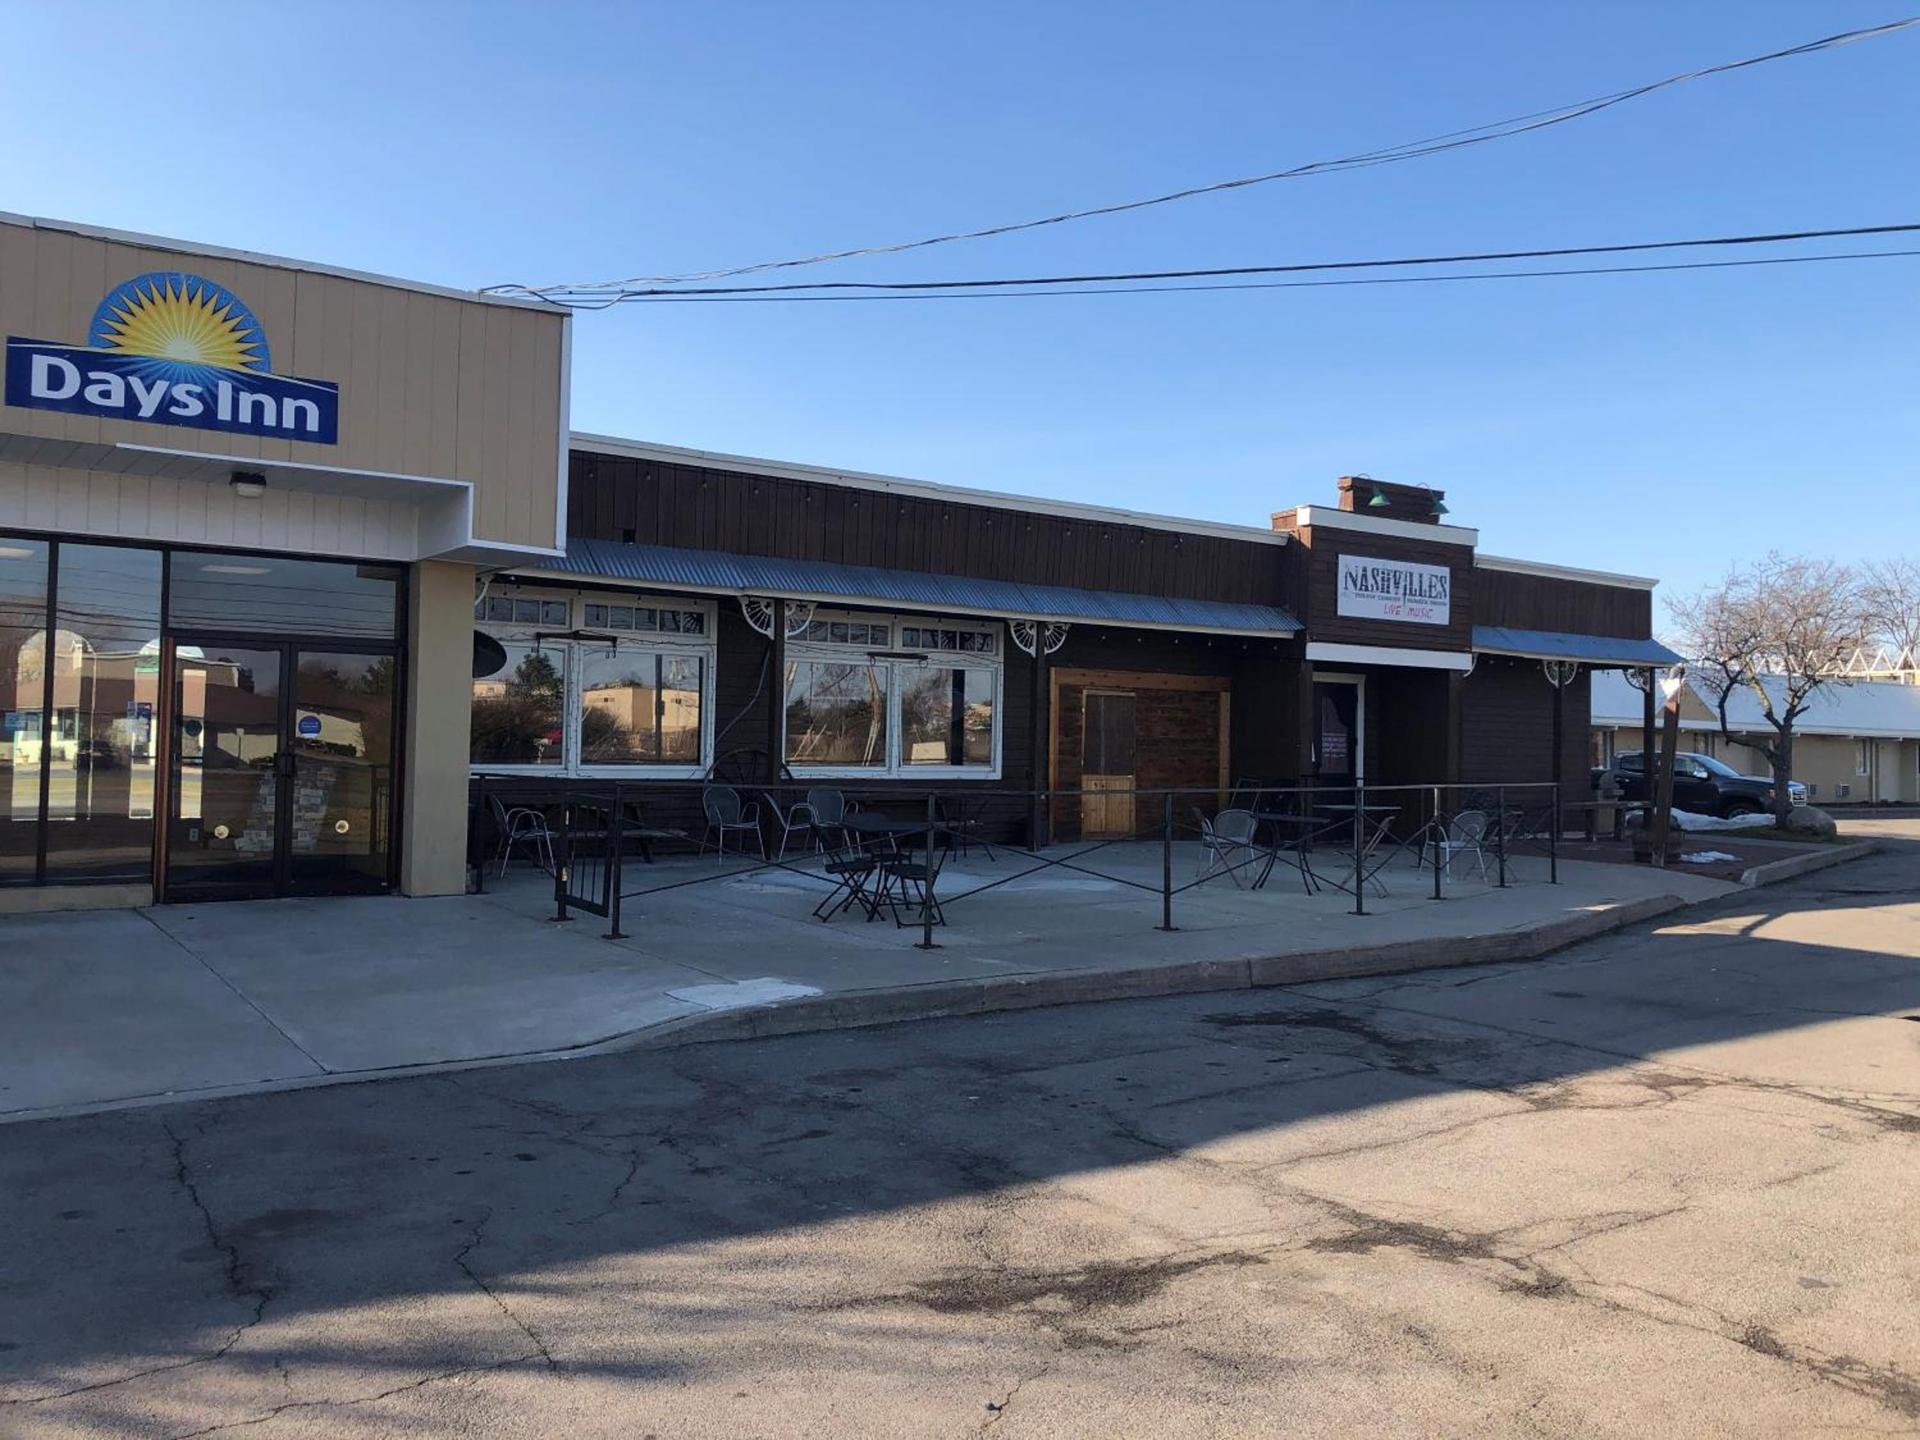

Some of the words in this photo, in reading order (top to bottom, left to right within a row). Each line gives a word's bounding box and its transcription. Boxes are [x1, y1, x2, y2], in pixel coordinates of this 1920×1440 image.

[30, 353, 205, 418] Days
[216, 379, 320, 433] Inn
[1343, 564, 1448, 602] NASHVILLES
[1384, 602, 1402, 616] LIVE
[1407, 606, 1433, 619] MUSIC
